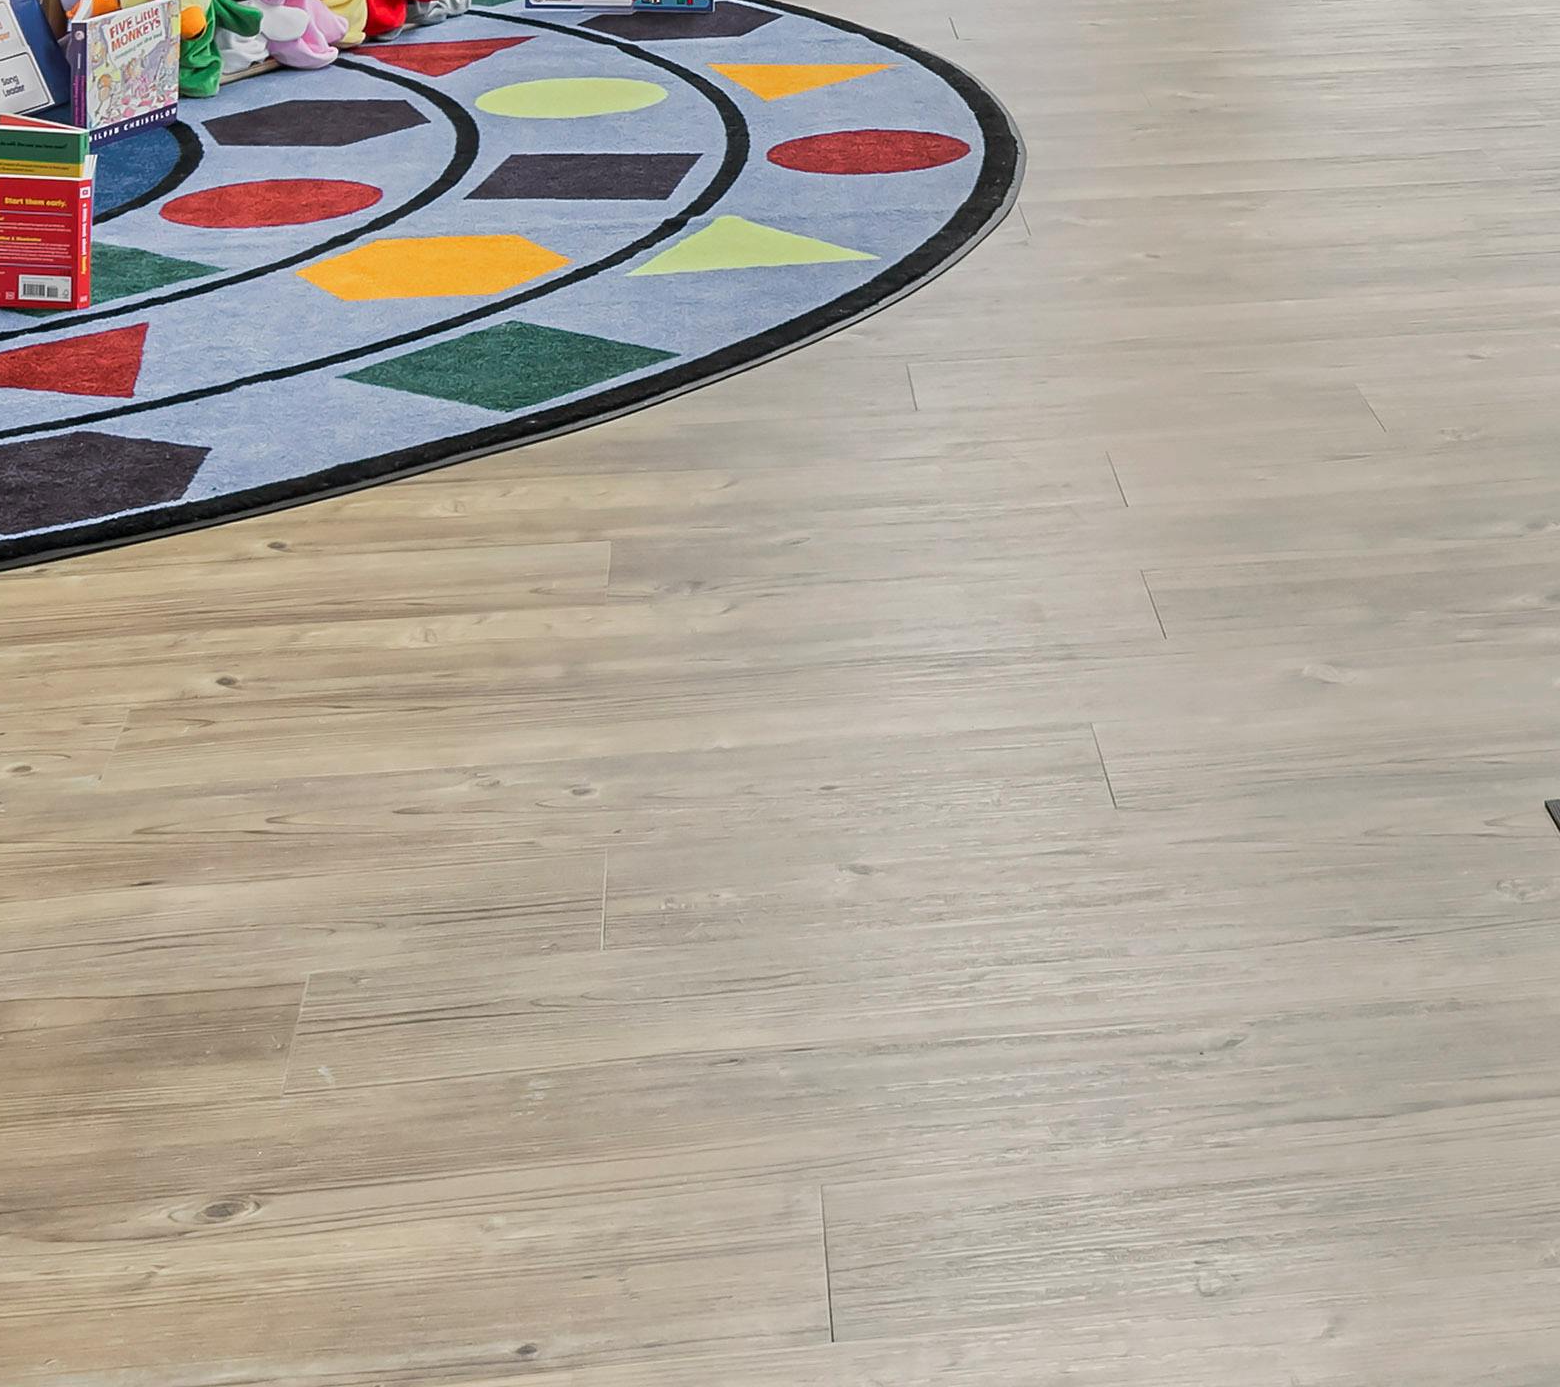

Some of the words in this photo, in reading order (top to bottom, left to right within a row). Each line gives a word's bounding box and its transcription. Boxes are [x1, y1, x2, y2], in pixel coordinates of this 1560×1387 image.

[109, 16, 132, 39] FIVE
[135, 7, 159, 25] Little
[111, 16, 161, 52] MONKEYS
[0, 75, 19, 88] Song
[2, 85, 25, 98] Leader
[4, 197, 23, 205] Start
[25, 198, 44, 206] them
